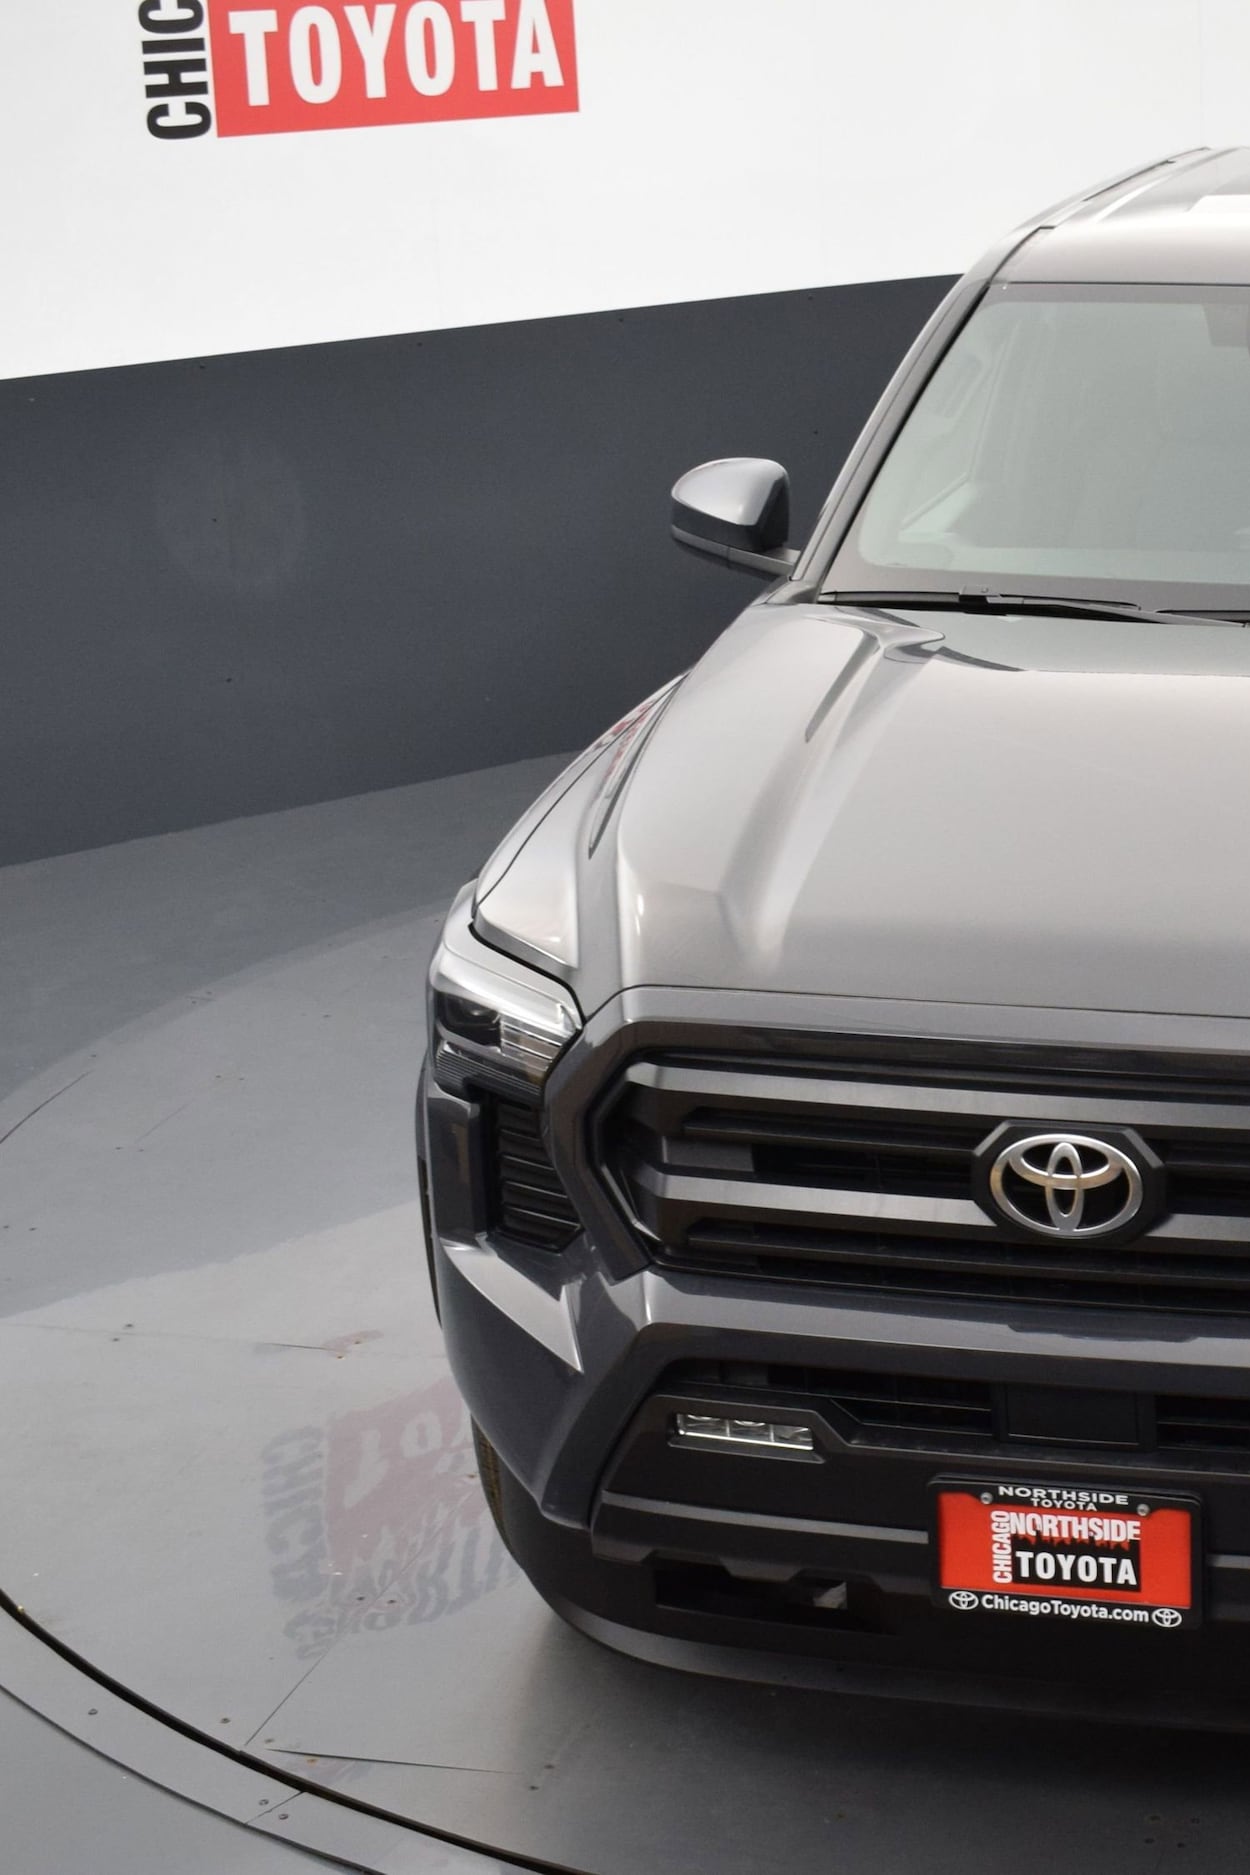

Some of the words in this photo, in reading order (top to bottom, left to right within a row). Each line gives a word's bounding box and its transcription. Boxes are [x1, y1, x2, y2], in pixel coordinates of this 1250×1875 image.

[229, 0, 565, 107] TOYOTA
[999, 1486, 1129, 1505] NORTHSIDE
[1031, 1498, 1097, 1511] TOYOTA
[1010, 1512, 1141, 1542] NORTHSIDE
[991, 1510, 1013, 1584] CHICAGO
[1015, 1551, 1137, 1585] TOYOTA
[982, 1595, 1149, 1622] ChicagoToyota.com
